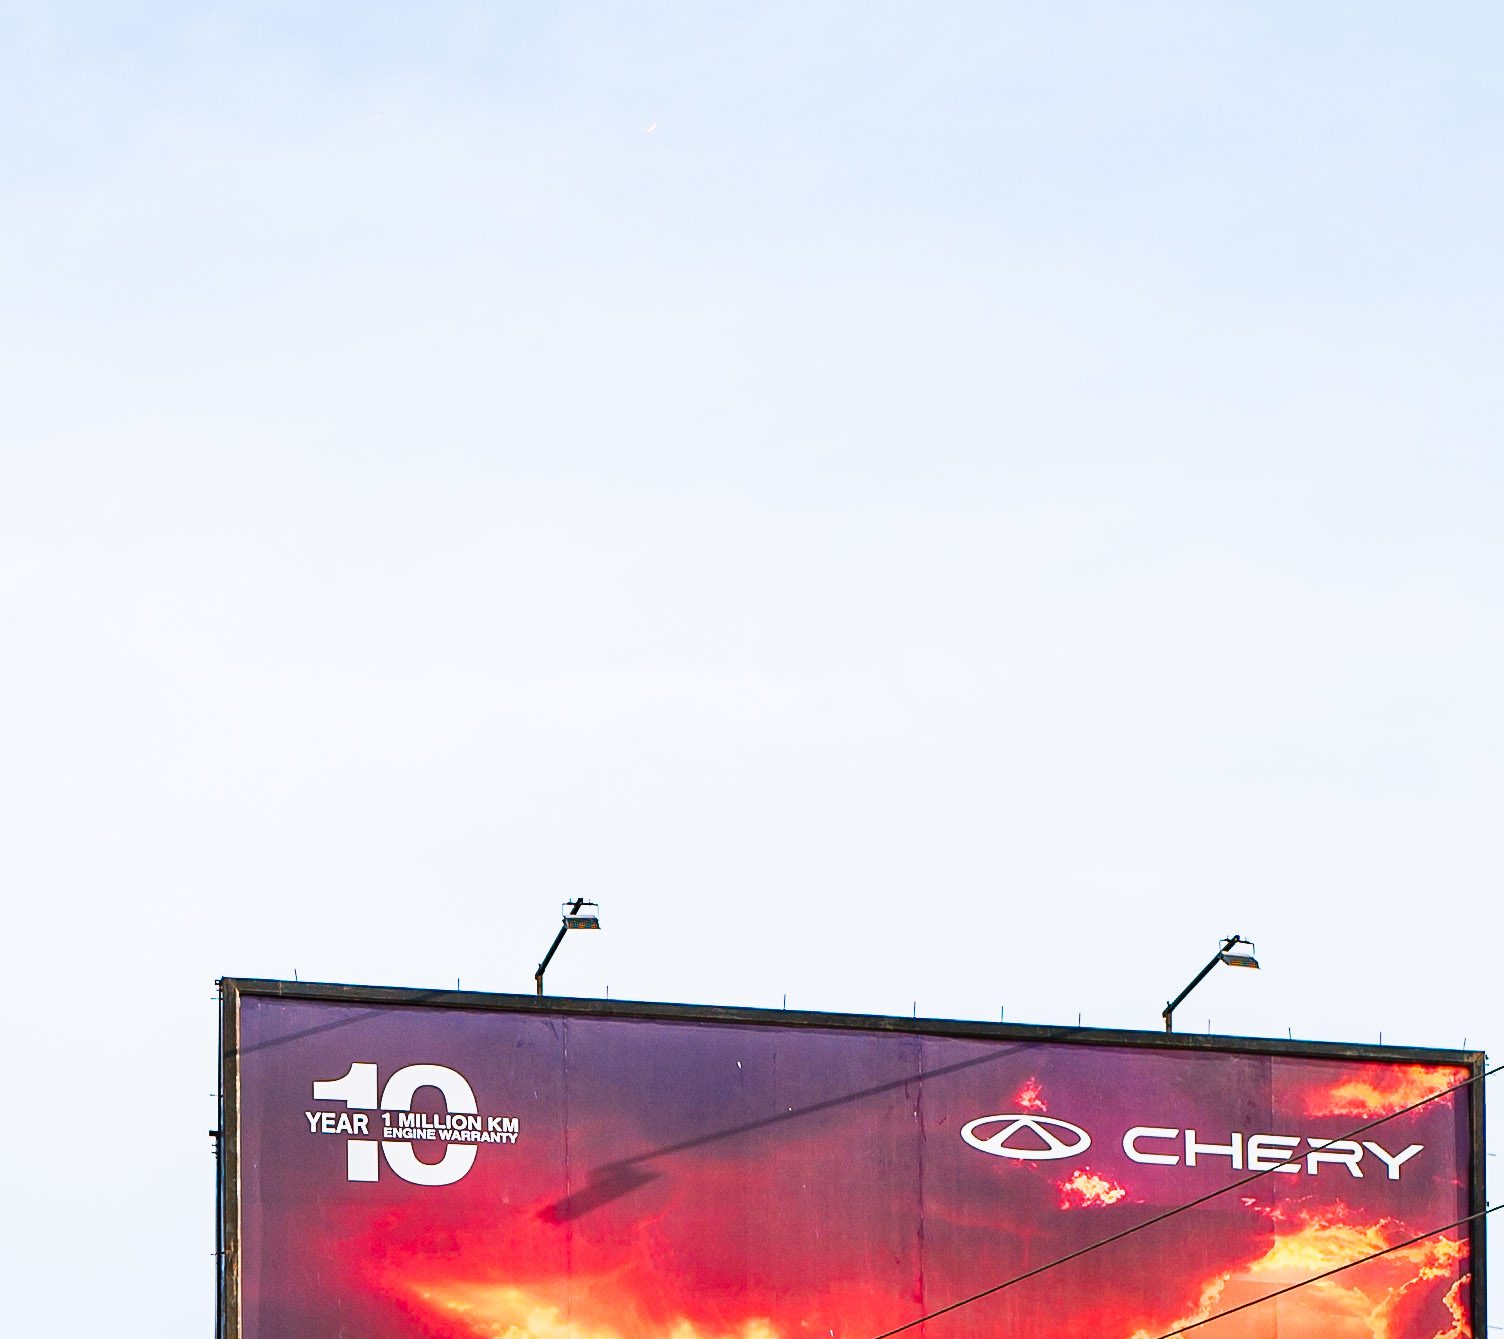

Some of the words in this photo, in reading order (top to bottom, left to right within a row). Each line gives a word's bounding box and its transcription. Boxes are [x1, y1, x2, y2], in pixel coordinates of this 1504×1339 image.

[305, 1111, 369, 1135] YEAR
[313, 1062, 478, 1186] 10
[381, 1112, 391, 1128] 1
[398, 1113, 482, 1131] MILLION
[487, 1117, 519, 1133] KM
[383, 1126, 436, 1140] ENGINE
[440, 1130, 518, 1144] WARRANTY
[1123, 1126, 1424, 1180] CHERY
